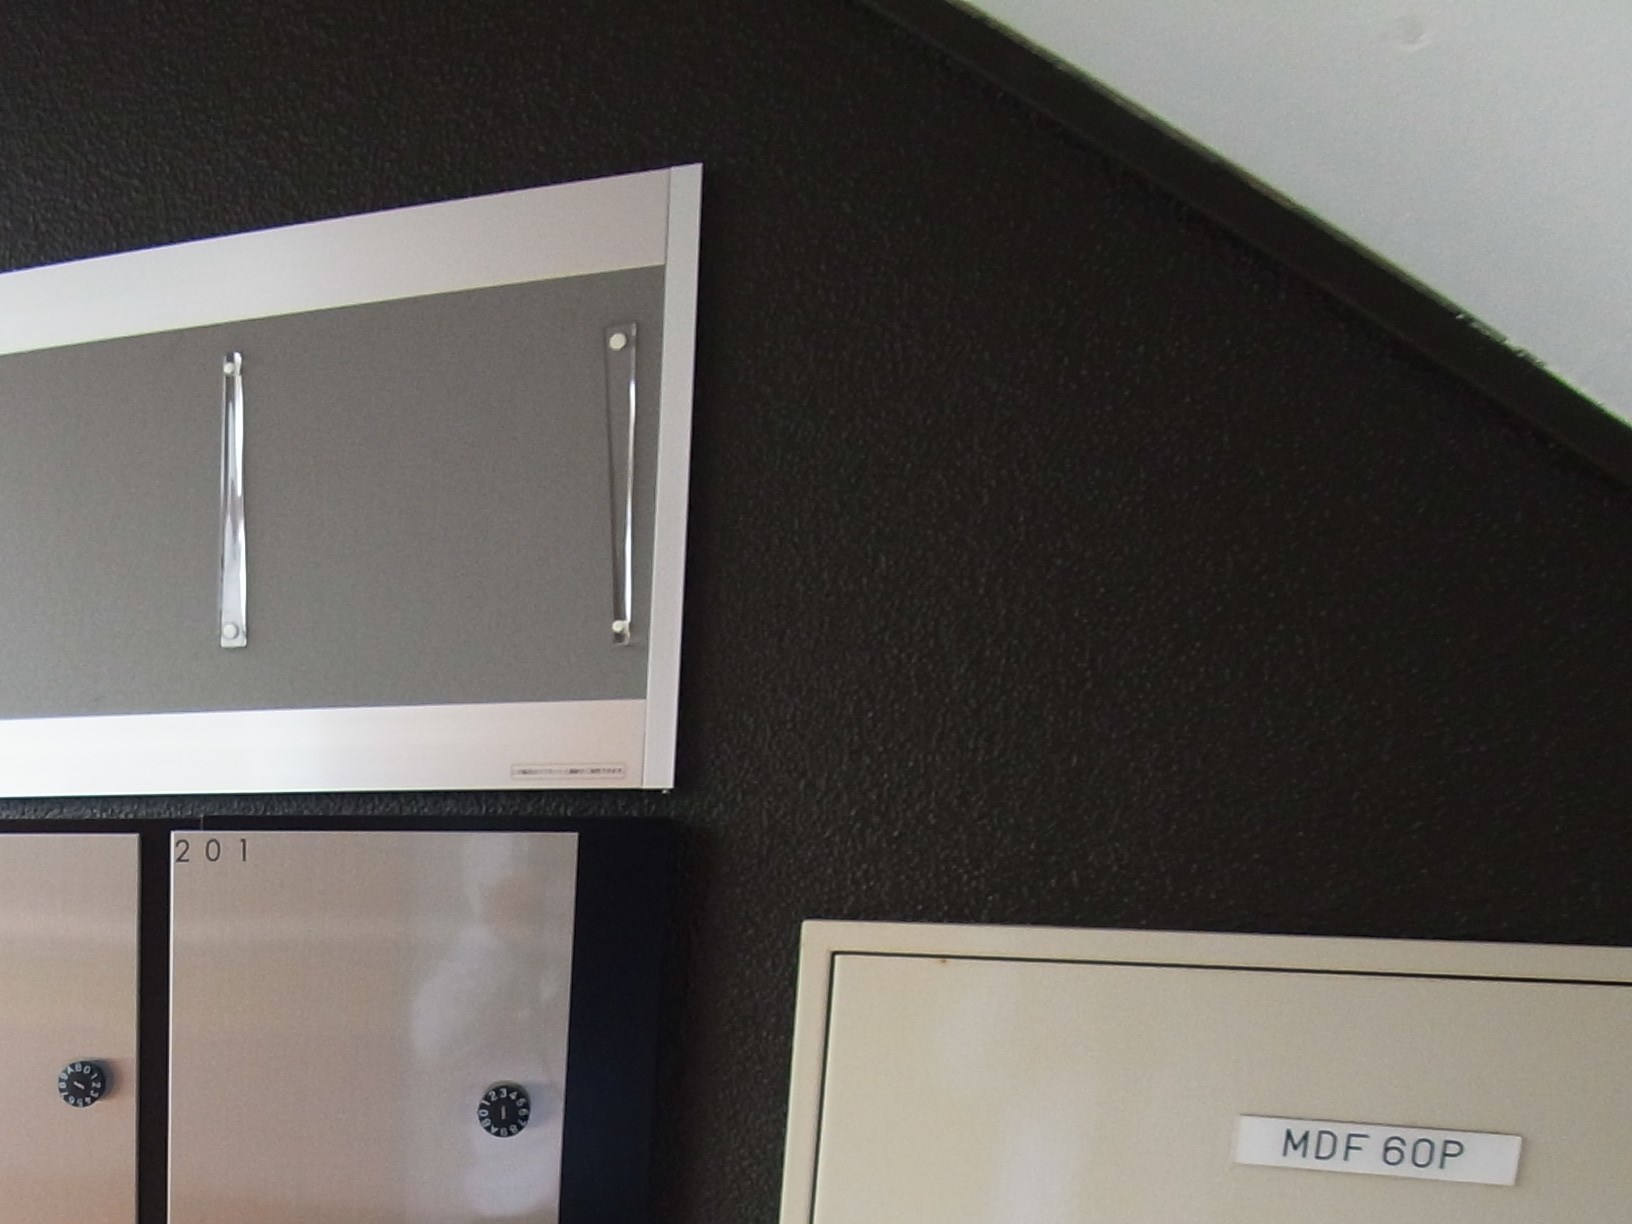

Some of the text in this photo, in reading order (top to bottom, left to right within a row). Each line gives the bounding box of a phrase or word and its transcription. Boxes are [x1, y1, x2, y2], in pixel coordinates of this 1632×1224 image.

[175, 838, 247, 863] 201
[1282, 1128, 1465, 1170] MDF 60P
